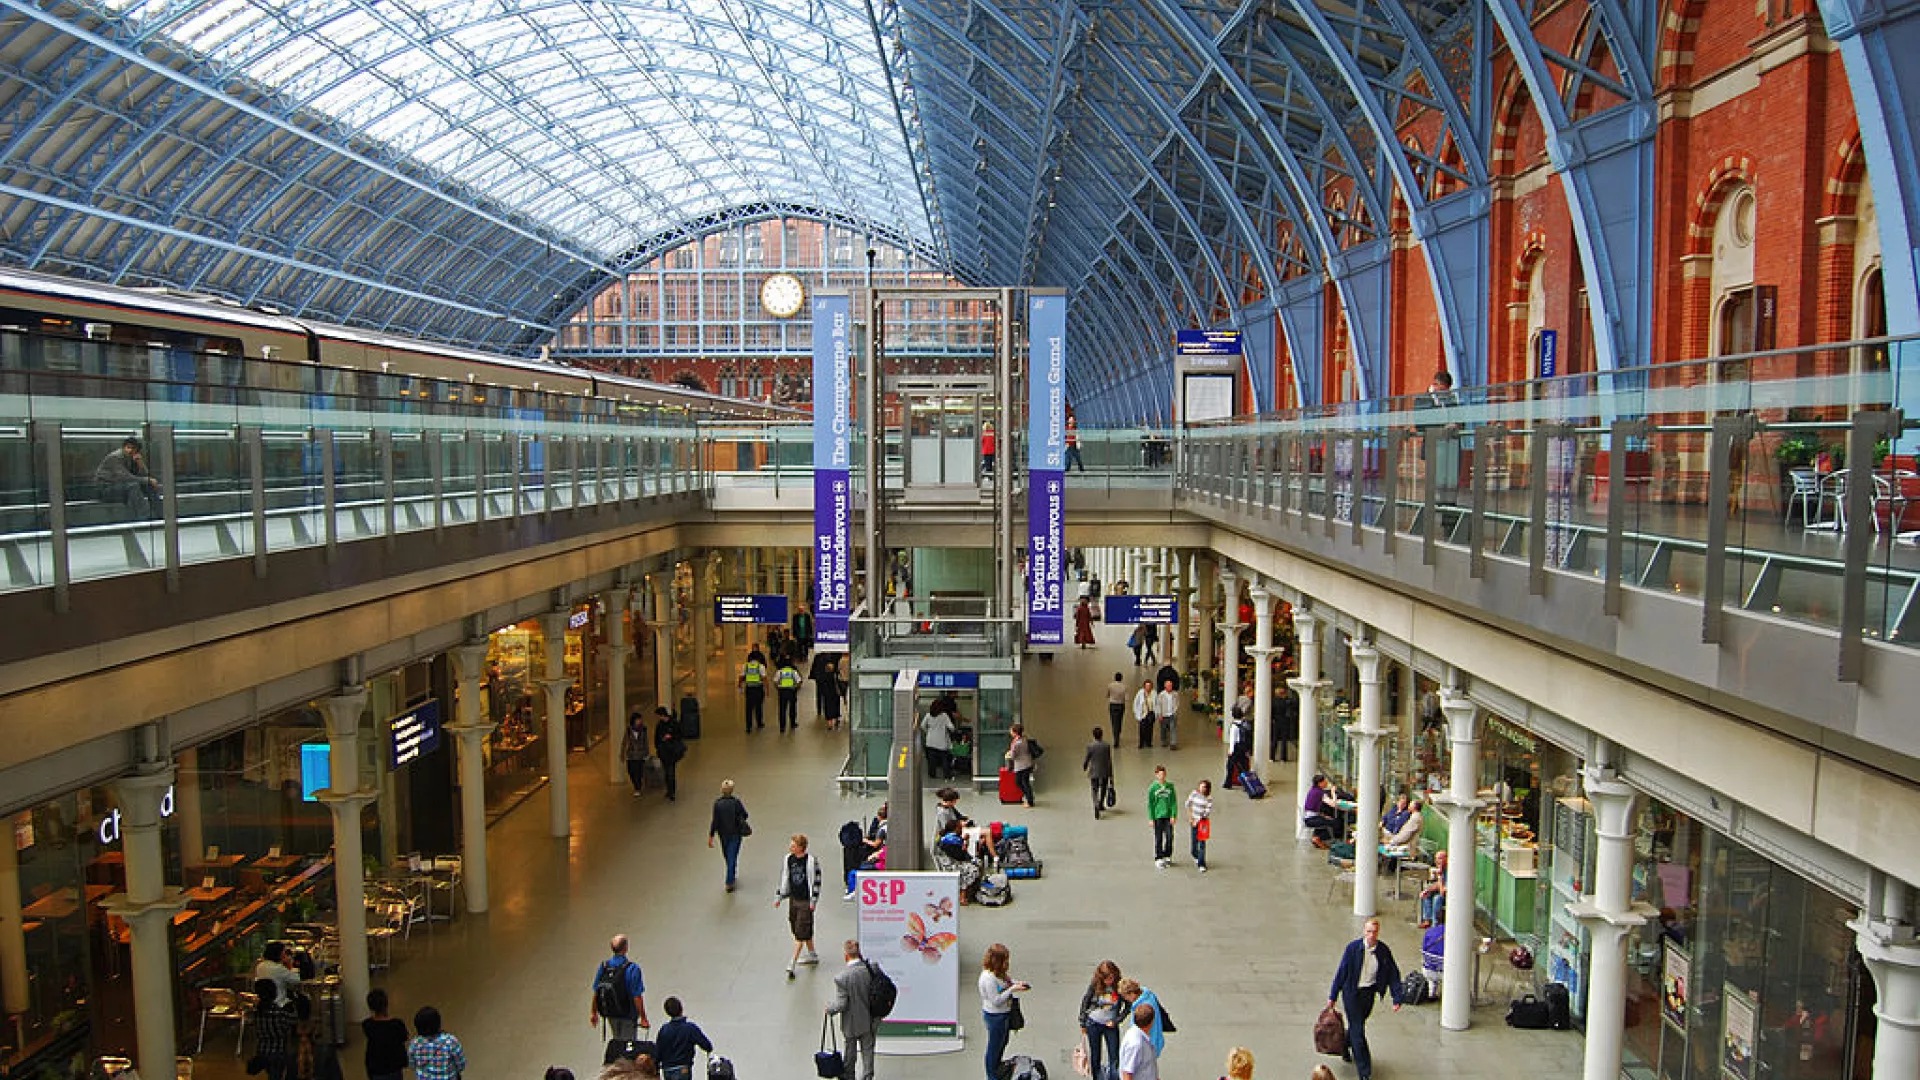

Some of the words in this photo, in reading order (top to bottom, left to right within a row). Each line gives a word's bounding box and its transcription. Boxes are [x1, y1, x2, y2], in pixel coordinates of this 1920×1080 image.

[831, 311, 844, 338] Bar
[1047, 336, 1061, 384] Grand
[831, 341, 848, 435] Champagne
[1047, 387, 1061, 447] Pancras
[831, 437, 844, 467] The
[819, 534, 832, 551] at
[833, 495, 847, 581] Rendezvous
[1032, 535, 1045, 552] at
[1046, 495, 1060, 581] Rendezvous
[818, 553, 833, 611] Upstairs
[833, 583, 847, 611] The
[1032, 554, 1046, 612] Upstairs
[1046, 583, 1060, 612] The
